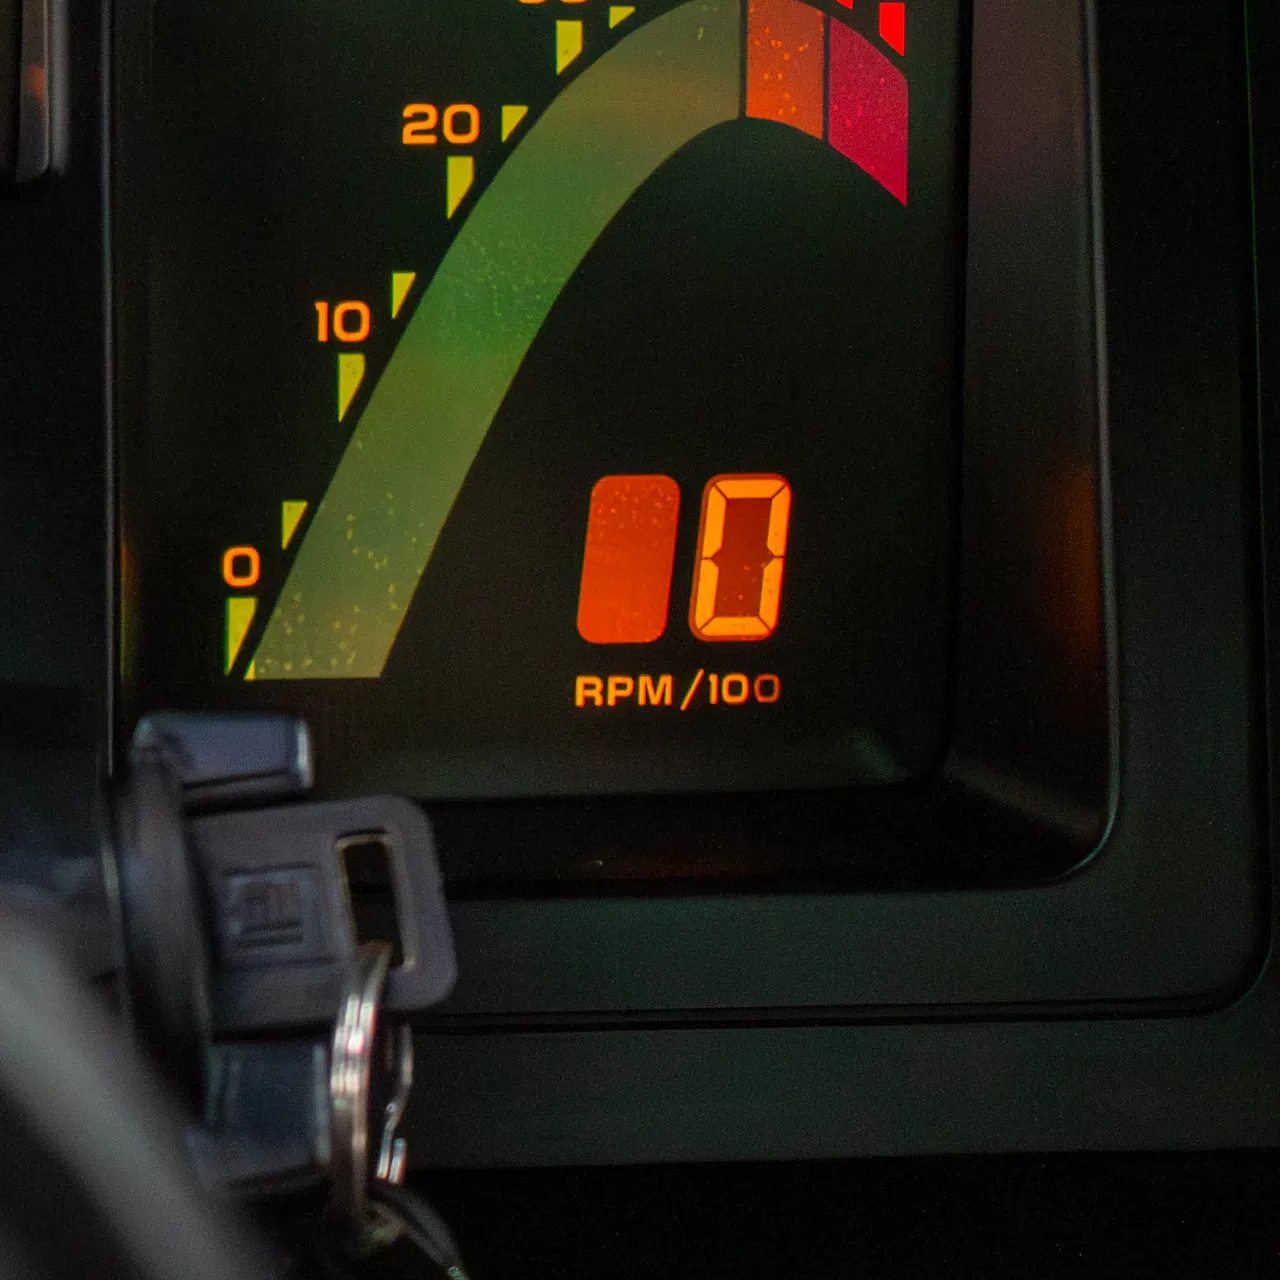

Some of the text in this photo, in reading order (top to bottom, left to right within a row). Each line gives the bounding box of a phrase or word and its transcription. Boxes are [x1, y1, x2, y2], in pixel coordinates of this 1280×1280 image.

[402, 103, 480, 145] 20
[314, 300, 371, 342] 10
[223, 546, 260, 587] 0
[694, 478, 790, 636] 0
